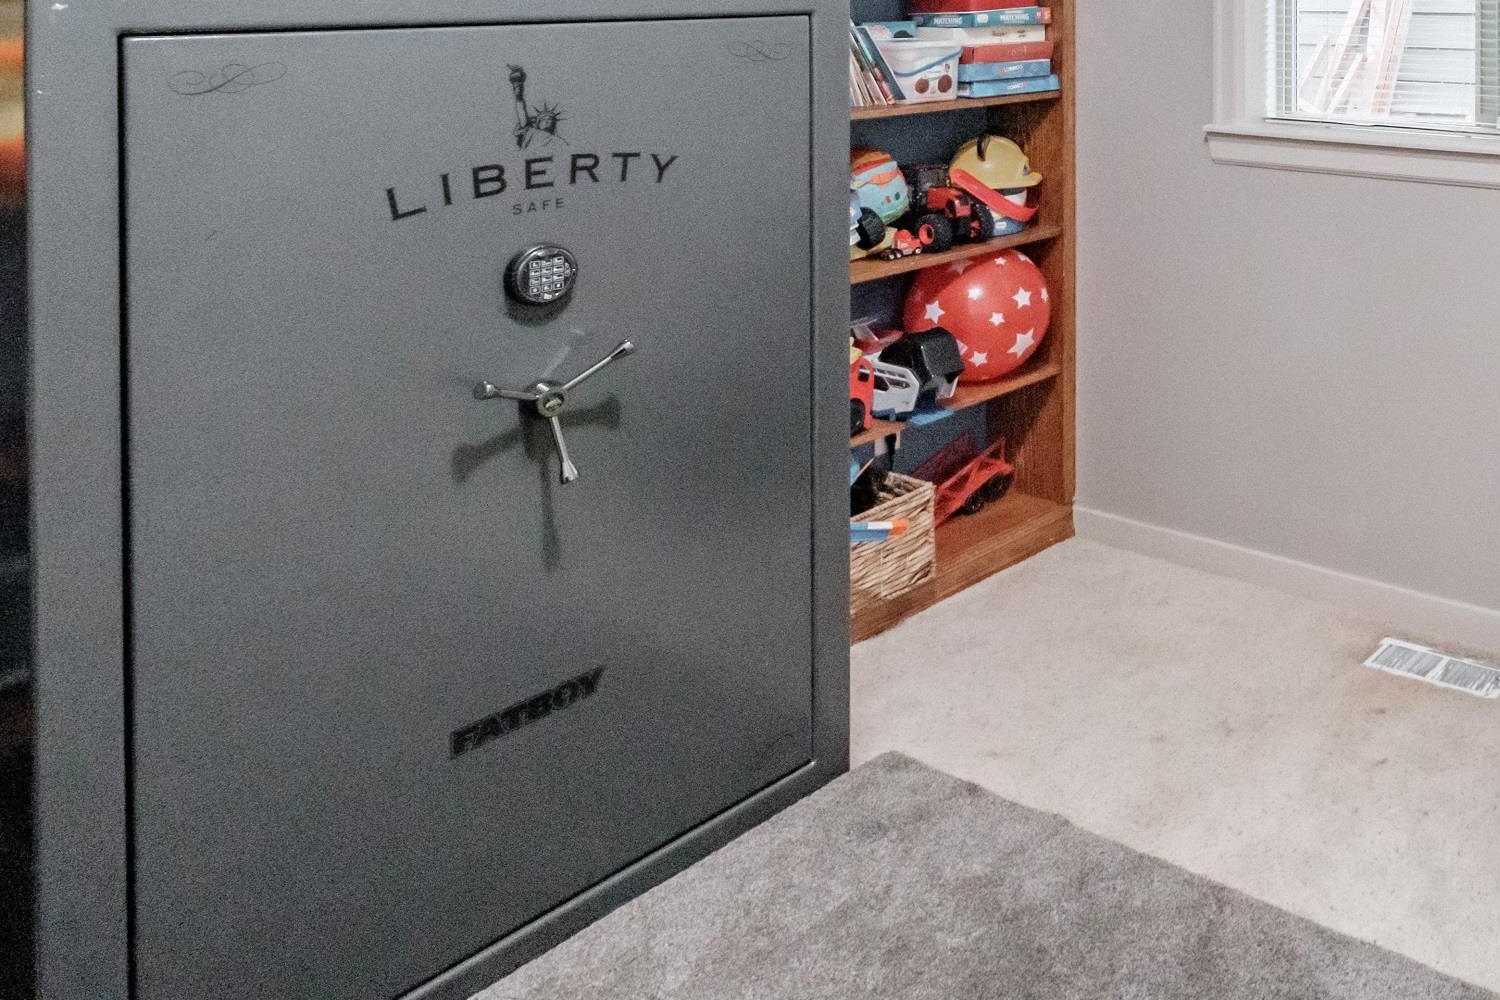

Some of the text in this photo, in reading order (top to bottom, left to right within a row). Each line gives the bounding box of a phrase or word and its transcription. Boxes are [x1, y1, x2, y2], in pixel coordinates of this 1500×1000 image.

[385, 152, 679, 221] LIBERTY
[512, 198, 565, 215] SAFE
[450, 664, 605, 761] FATBOY
